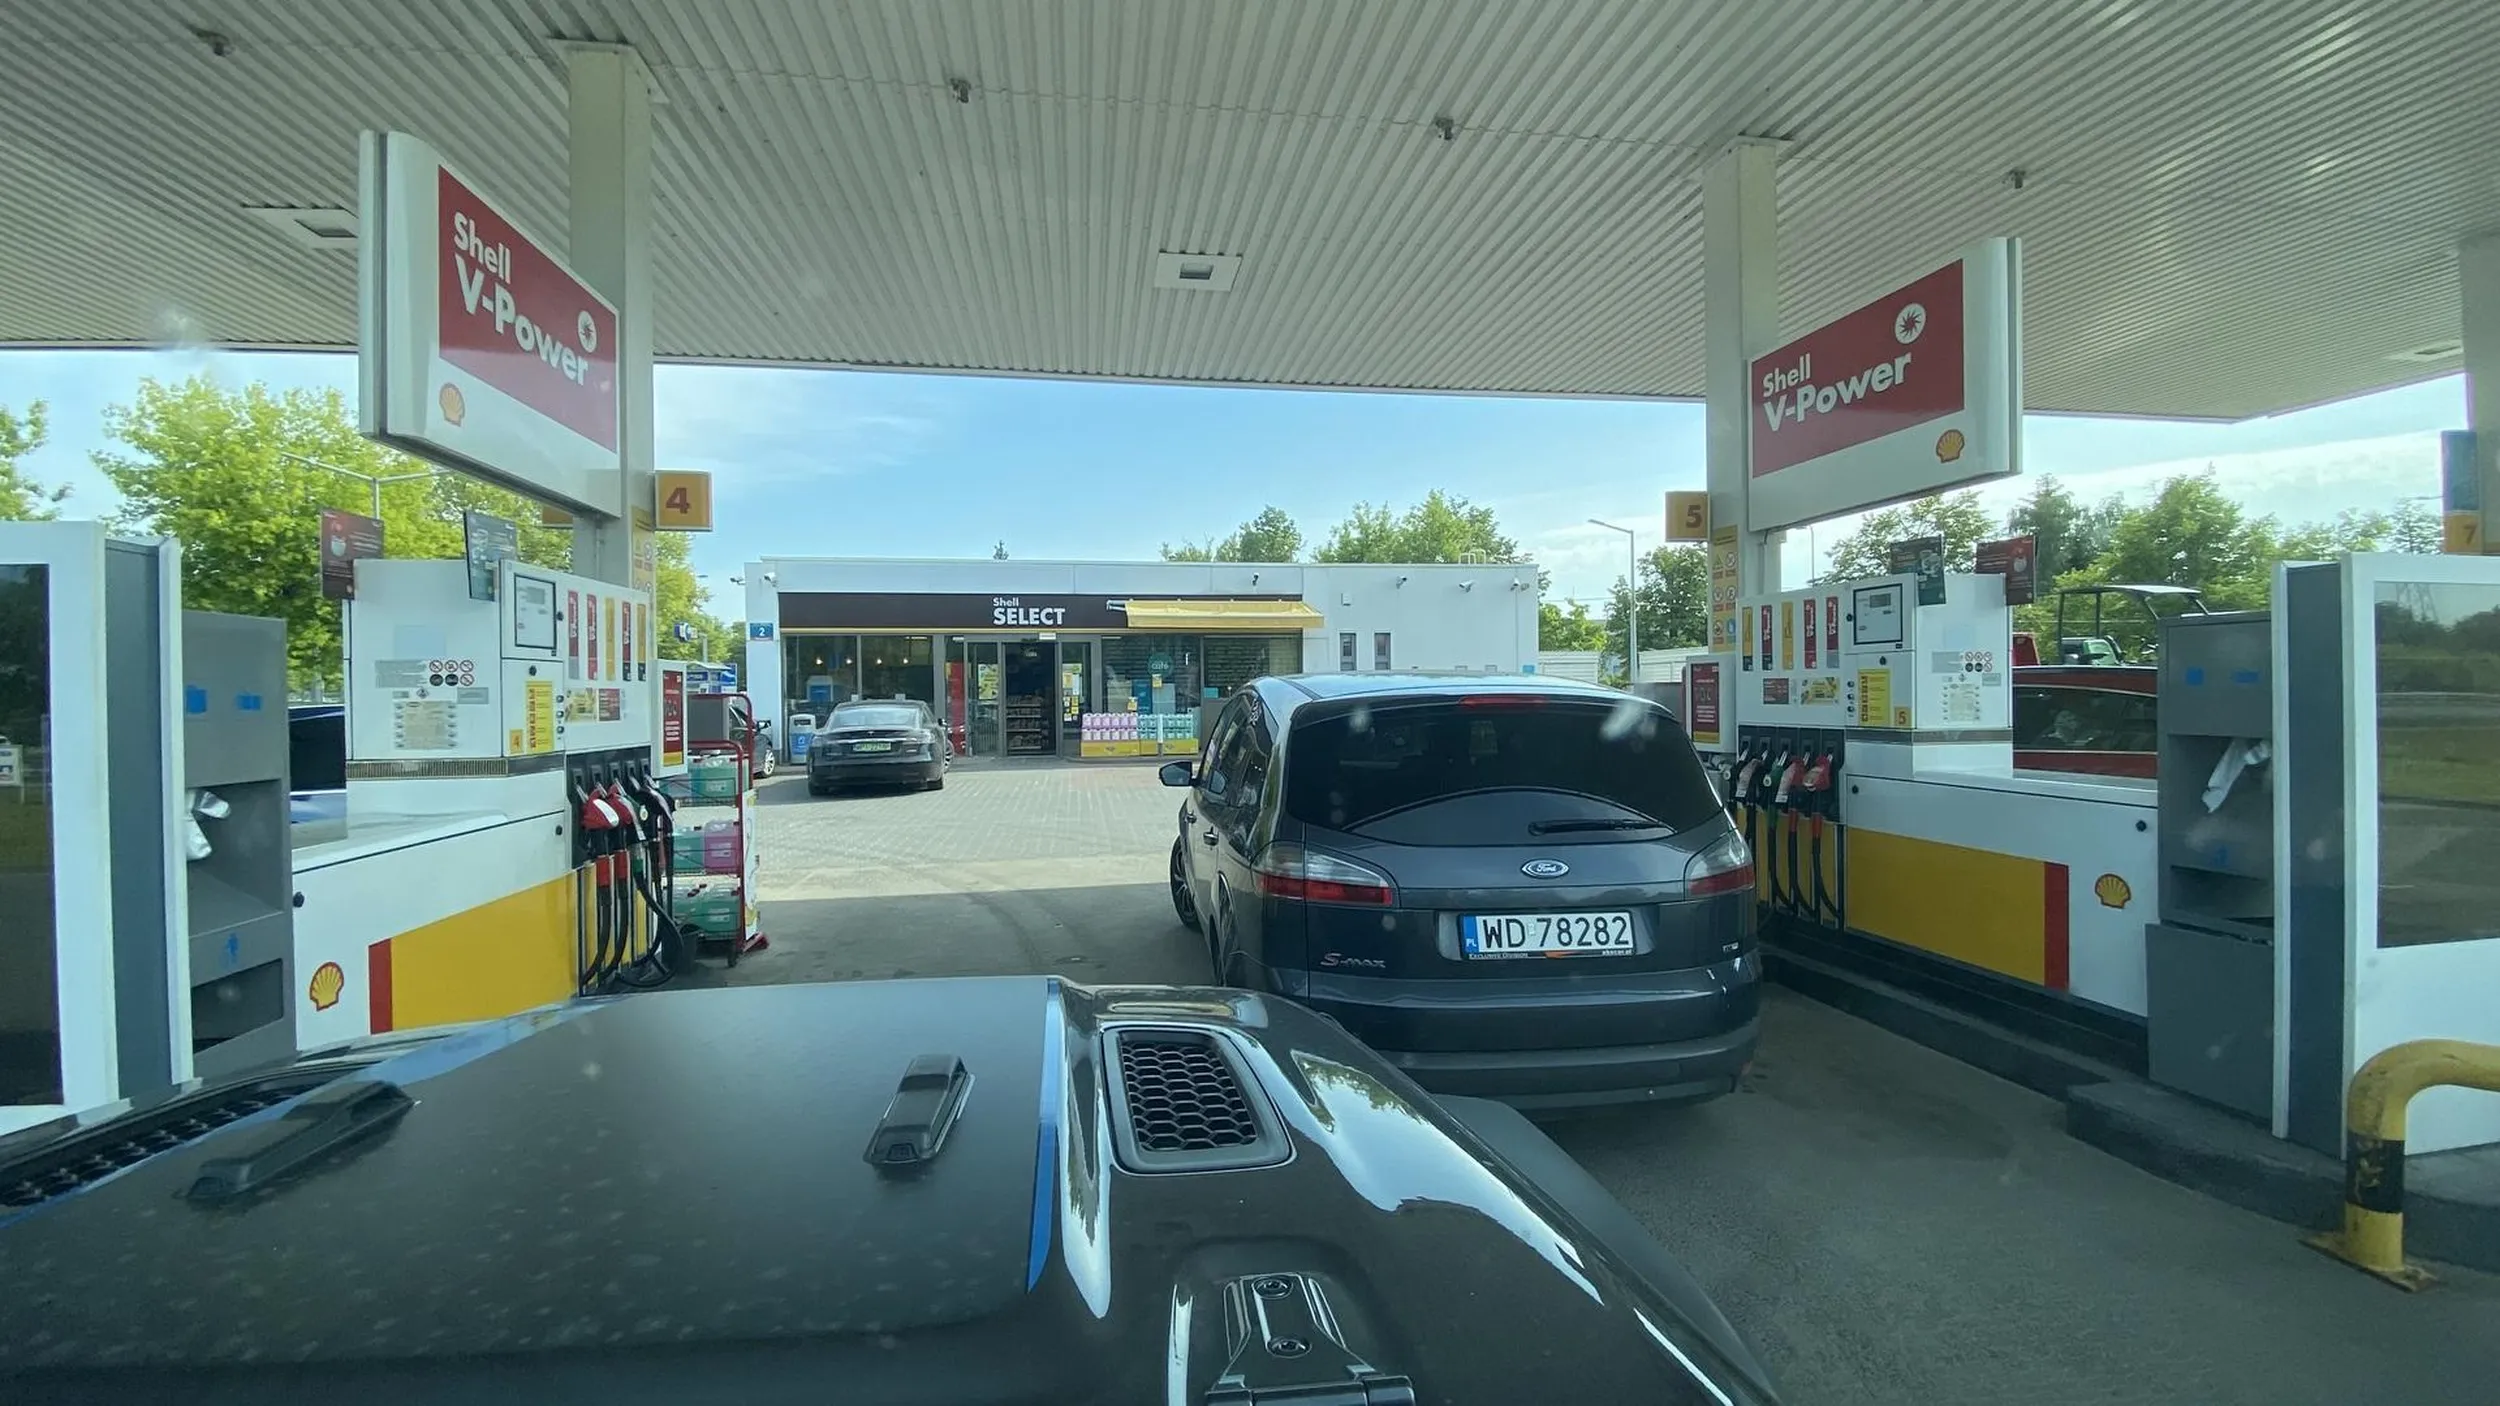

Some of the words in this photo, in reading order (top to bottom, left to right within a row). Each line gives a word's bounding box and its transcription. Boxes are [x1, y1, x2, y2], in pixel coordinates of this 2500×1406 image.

[454, 211, 511, 284] Shell
[454, 254, 588, 386] V-Power
[1762, 353, 1811, 398] Shell
[1763, 351, 1912, 432] V-Power
[665, 487, 691, 514] 4
[1686, 504, 1703, 528] 5
[2463, 523, 2478, 546] 7
[993, 597, 1019, 607] Shell
[993, 607, 1066, 626] SELECT
[758, 626, 766, 636] 2
[1898, 711, 1907, 725] 5
[1466, 938, 1477, 948] PL
[1482, 918, 1526, 949] WD
[1536, 915, 1630, 948] 78282
